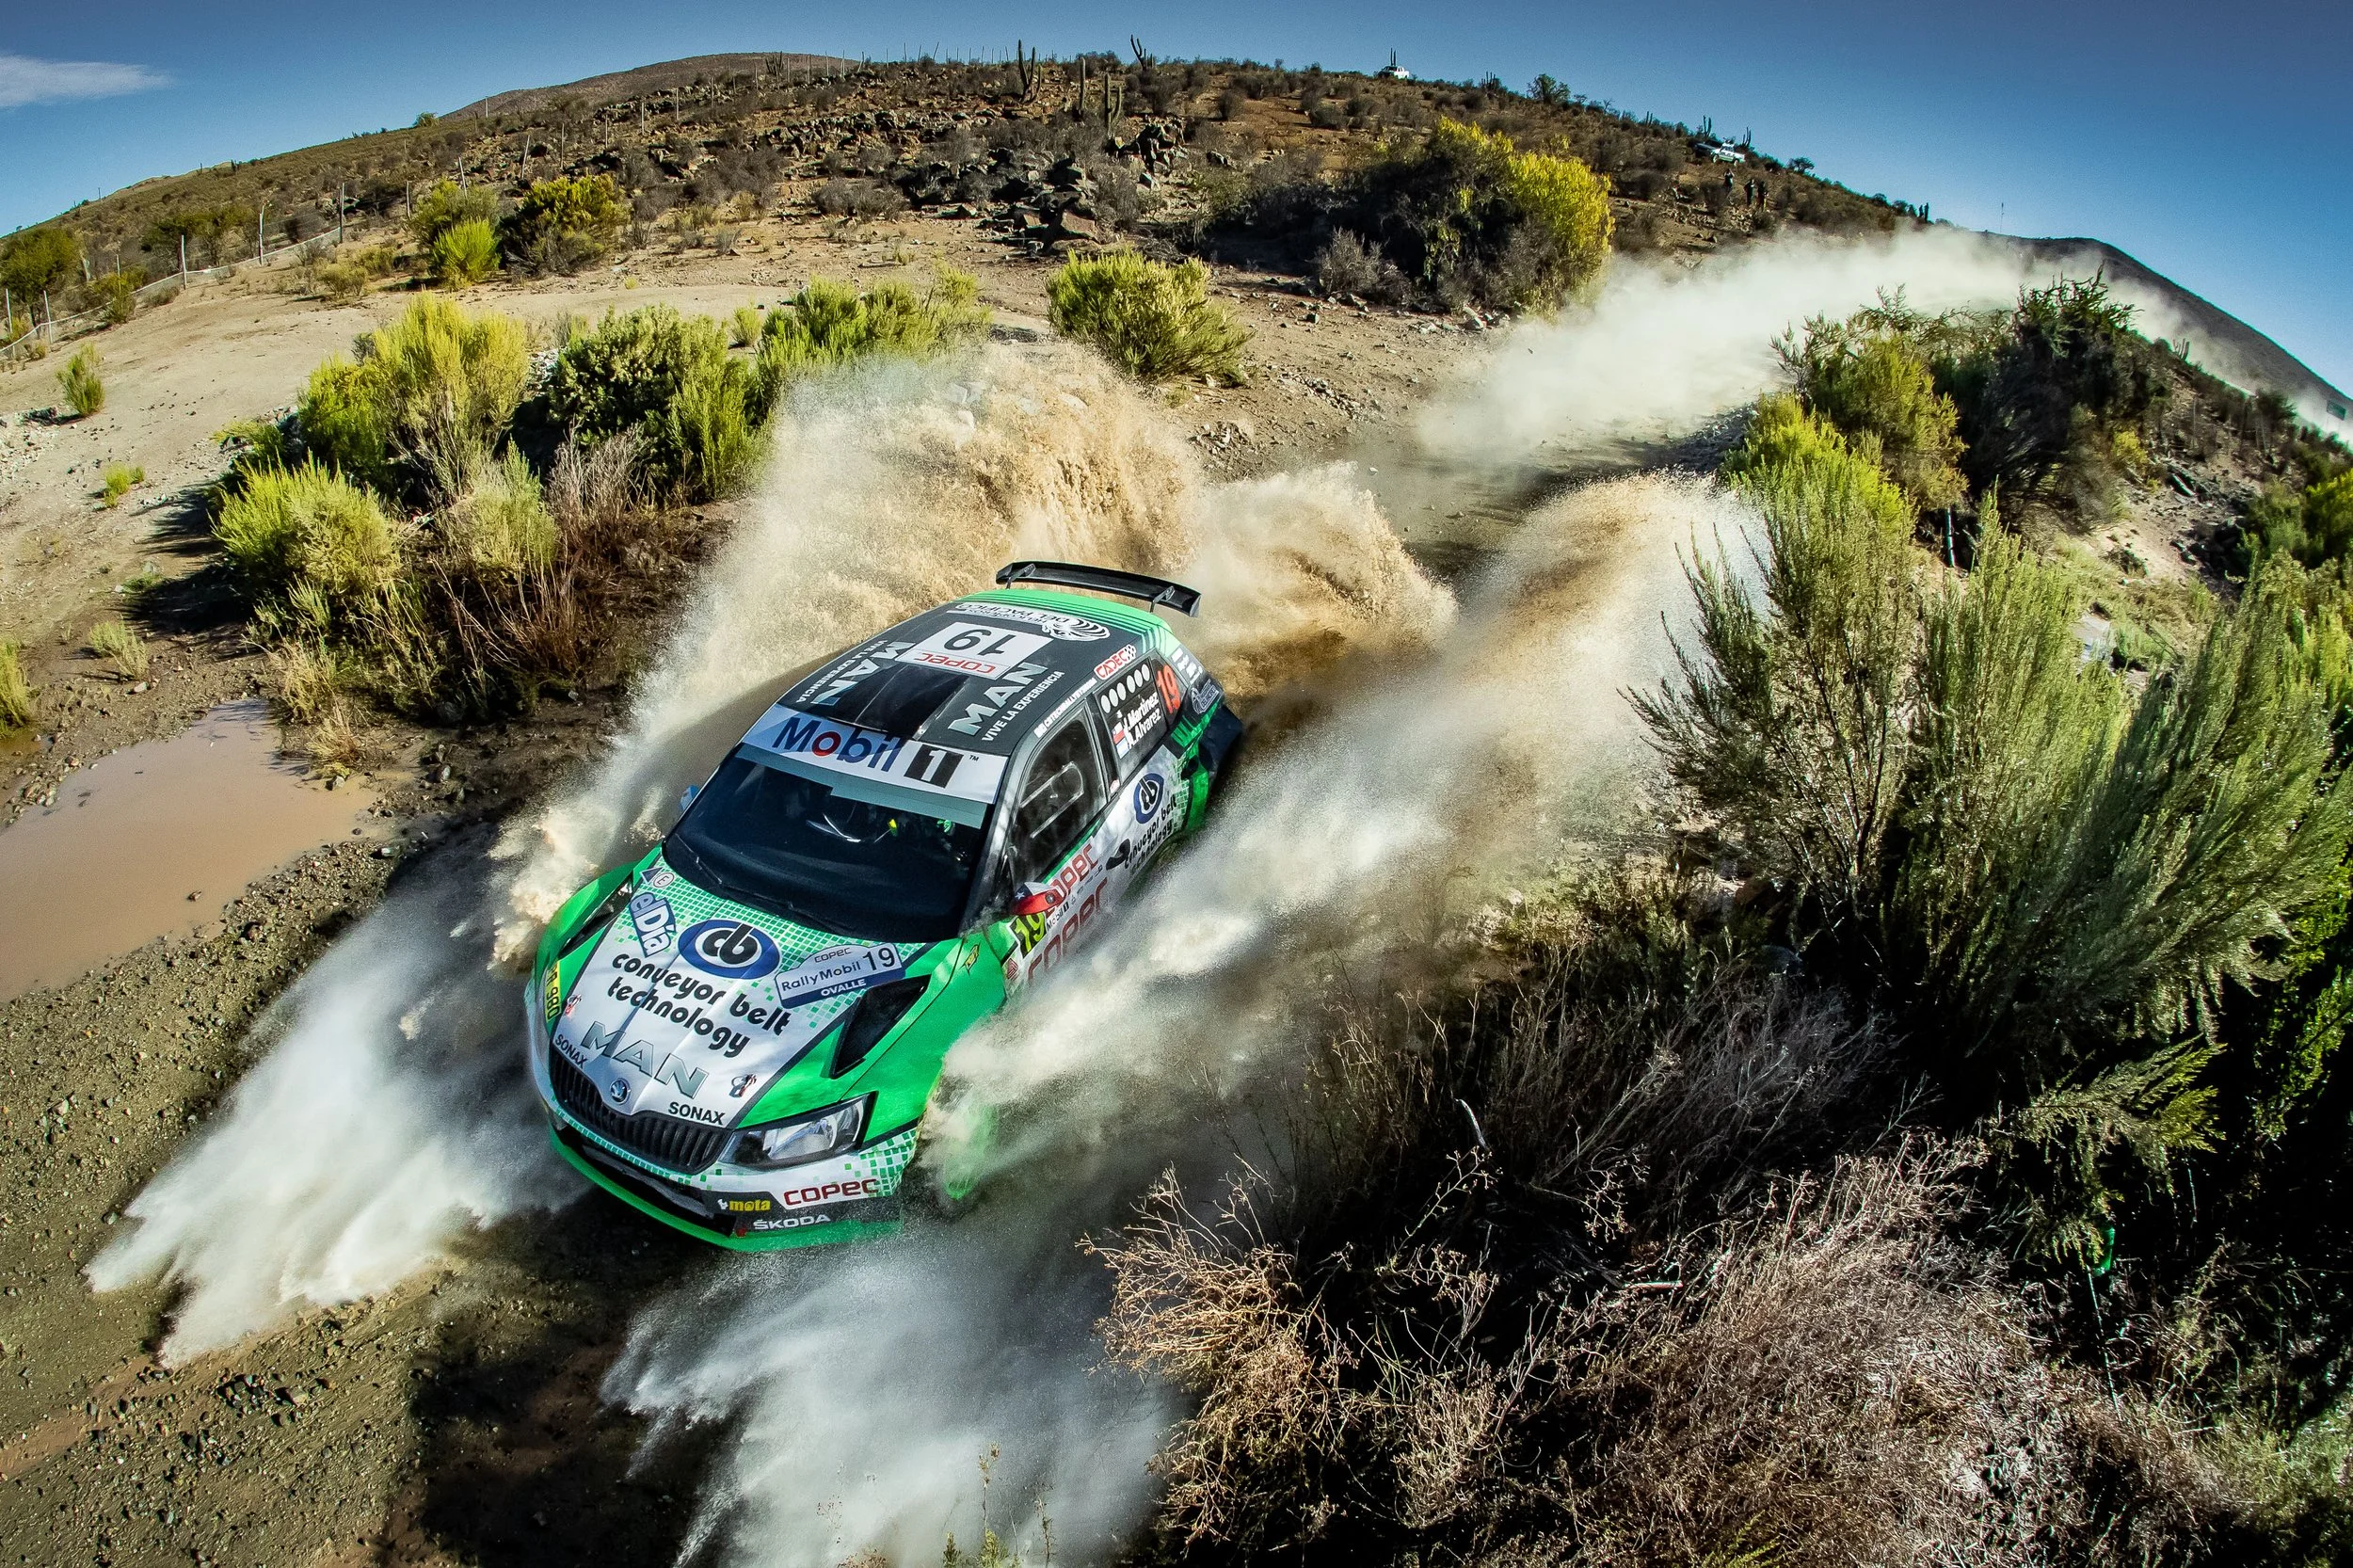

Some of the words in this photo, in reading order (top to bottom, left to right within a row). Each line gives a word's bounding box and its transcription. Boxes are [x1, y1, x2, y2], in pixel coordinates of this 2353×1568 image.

[944, 629, 1016, 657] 19
[1096, 650, 1128, 678] CADEC
[810, 641, 917, 707] MAN
[1157, 664, 1181, 714] 19
[948, 662, 1048, 736] MAN
[982, 720, 1008, 742] VIVE
[1001, 709, 1019, 722] LA
[1013, 670, 1065, 711] EXPERIENCIA
[772, 717, 902, 773] Mobil
[1015, 911, 1045, 952] 19
[863, 947, 895, 971] 19
[612, 953, 727, 1006] conveyor
[729, 993, 792, 1036] belt
[821, 979, 867, 997] OVALLE
[607, 976, 751, 1058] technology
[555, 1033, 588, 1069] SONAX
[581, 1020, 710, 1099] MAN
[668, 1101, 727, 1126] SONAX
[753, 1214, 831, 1230] ŠKODA
